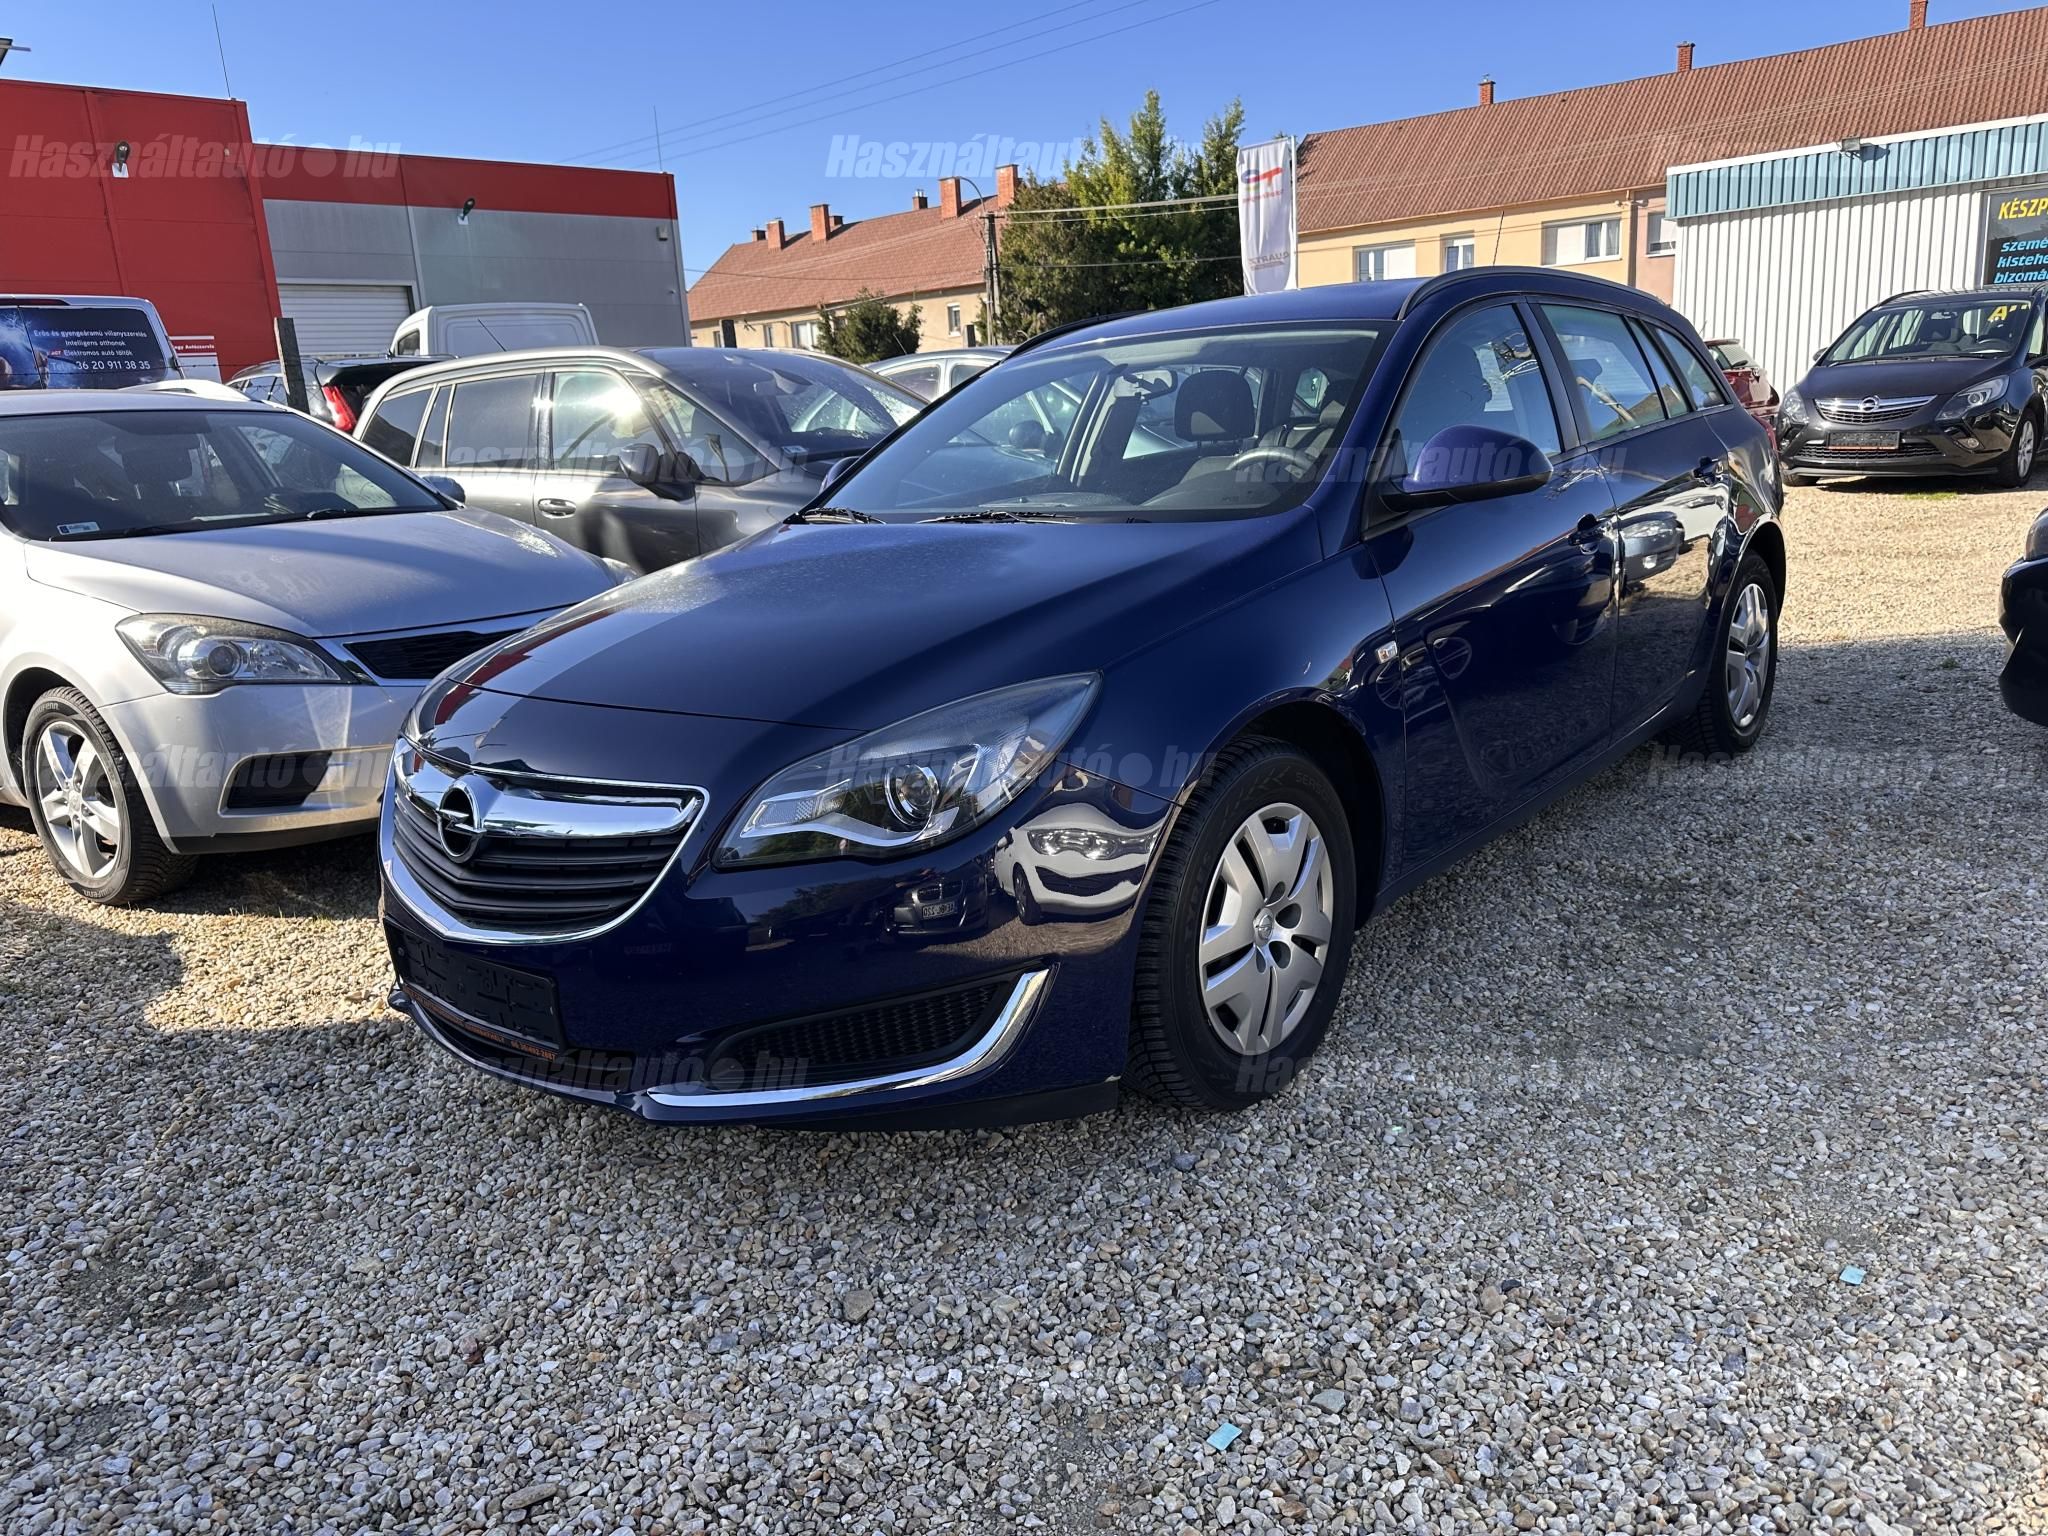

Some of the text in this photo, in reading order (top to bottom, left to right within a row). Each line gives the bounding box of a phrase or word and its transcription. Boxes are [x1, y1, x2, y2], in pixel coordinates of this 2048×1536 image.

[2001, 237, 2048, 253] szemé
[91, 360, 105, 370] 20
[107, 360, 122, 370] 911
[124, 360, 137, 370] 38
[138, 360, 151, 370] 35
